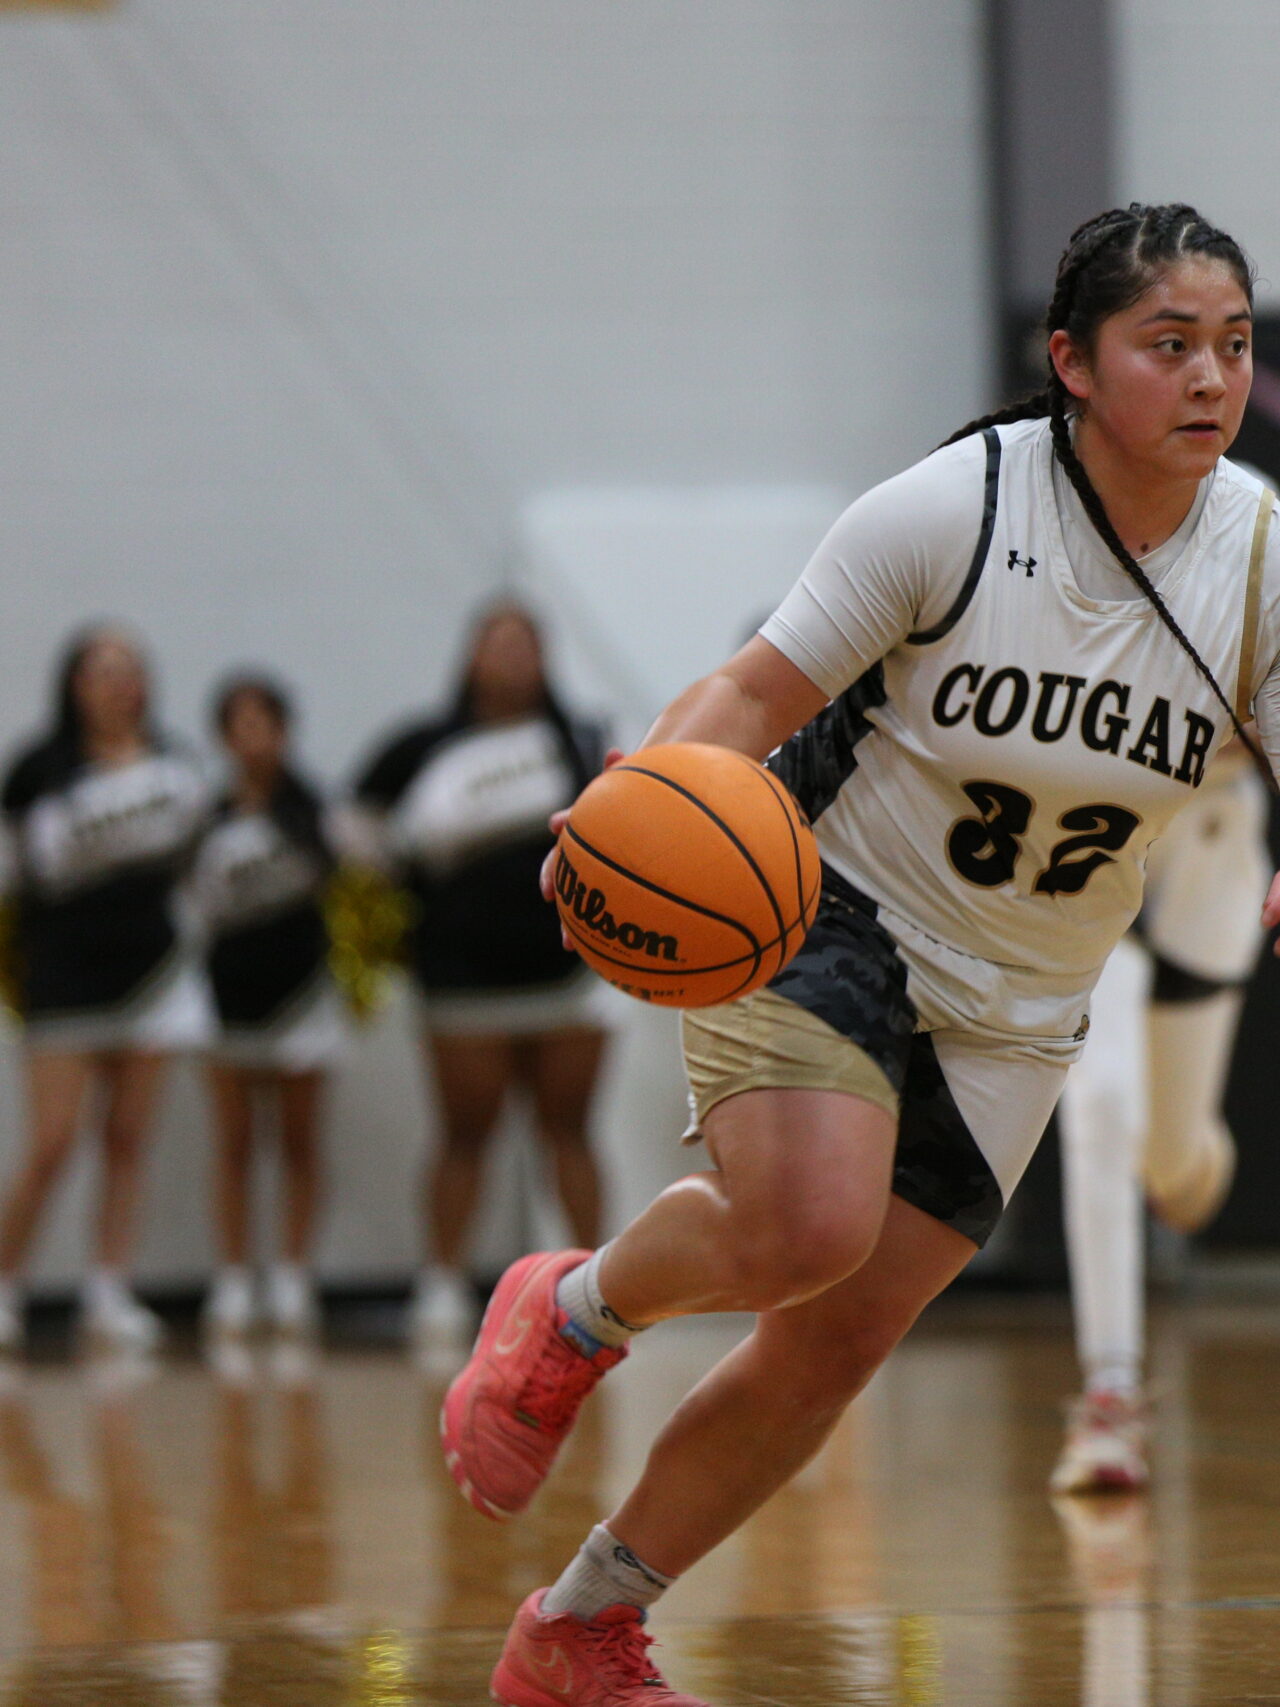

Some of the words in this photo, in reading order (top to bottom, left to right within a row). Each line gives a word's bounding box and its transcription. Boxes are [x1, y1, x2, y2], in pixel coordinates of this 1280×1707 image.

[931, 662, 1215, 789] COUGAR
[944, 778, 1144, 898] 32
[556, 848, 679, 962] Wilson
